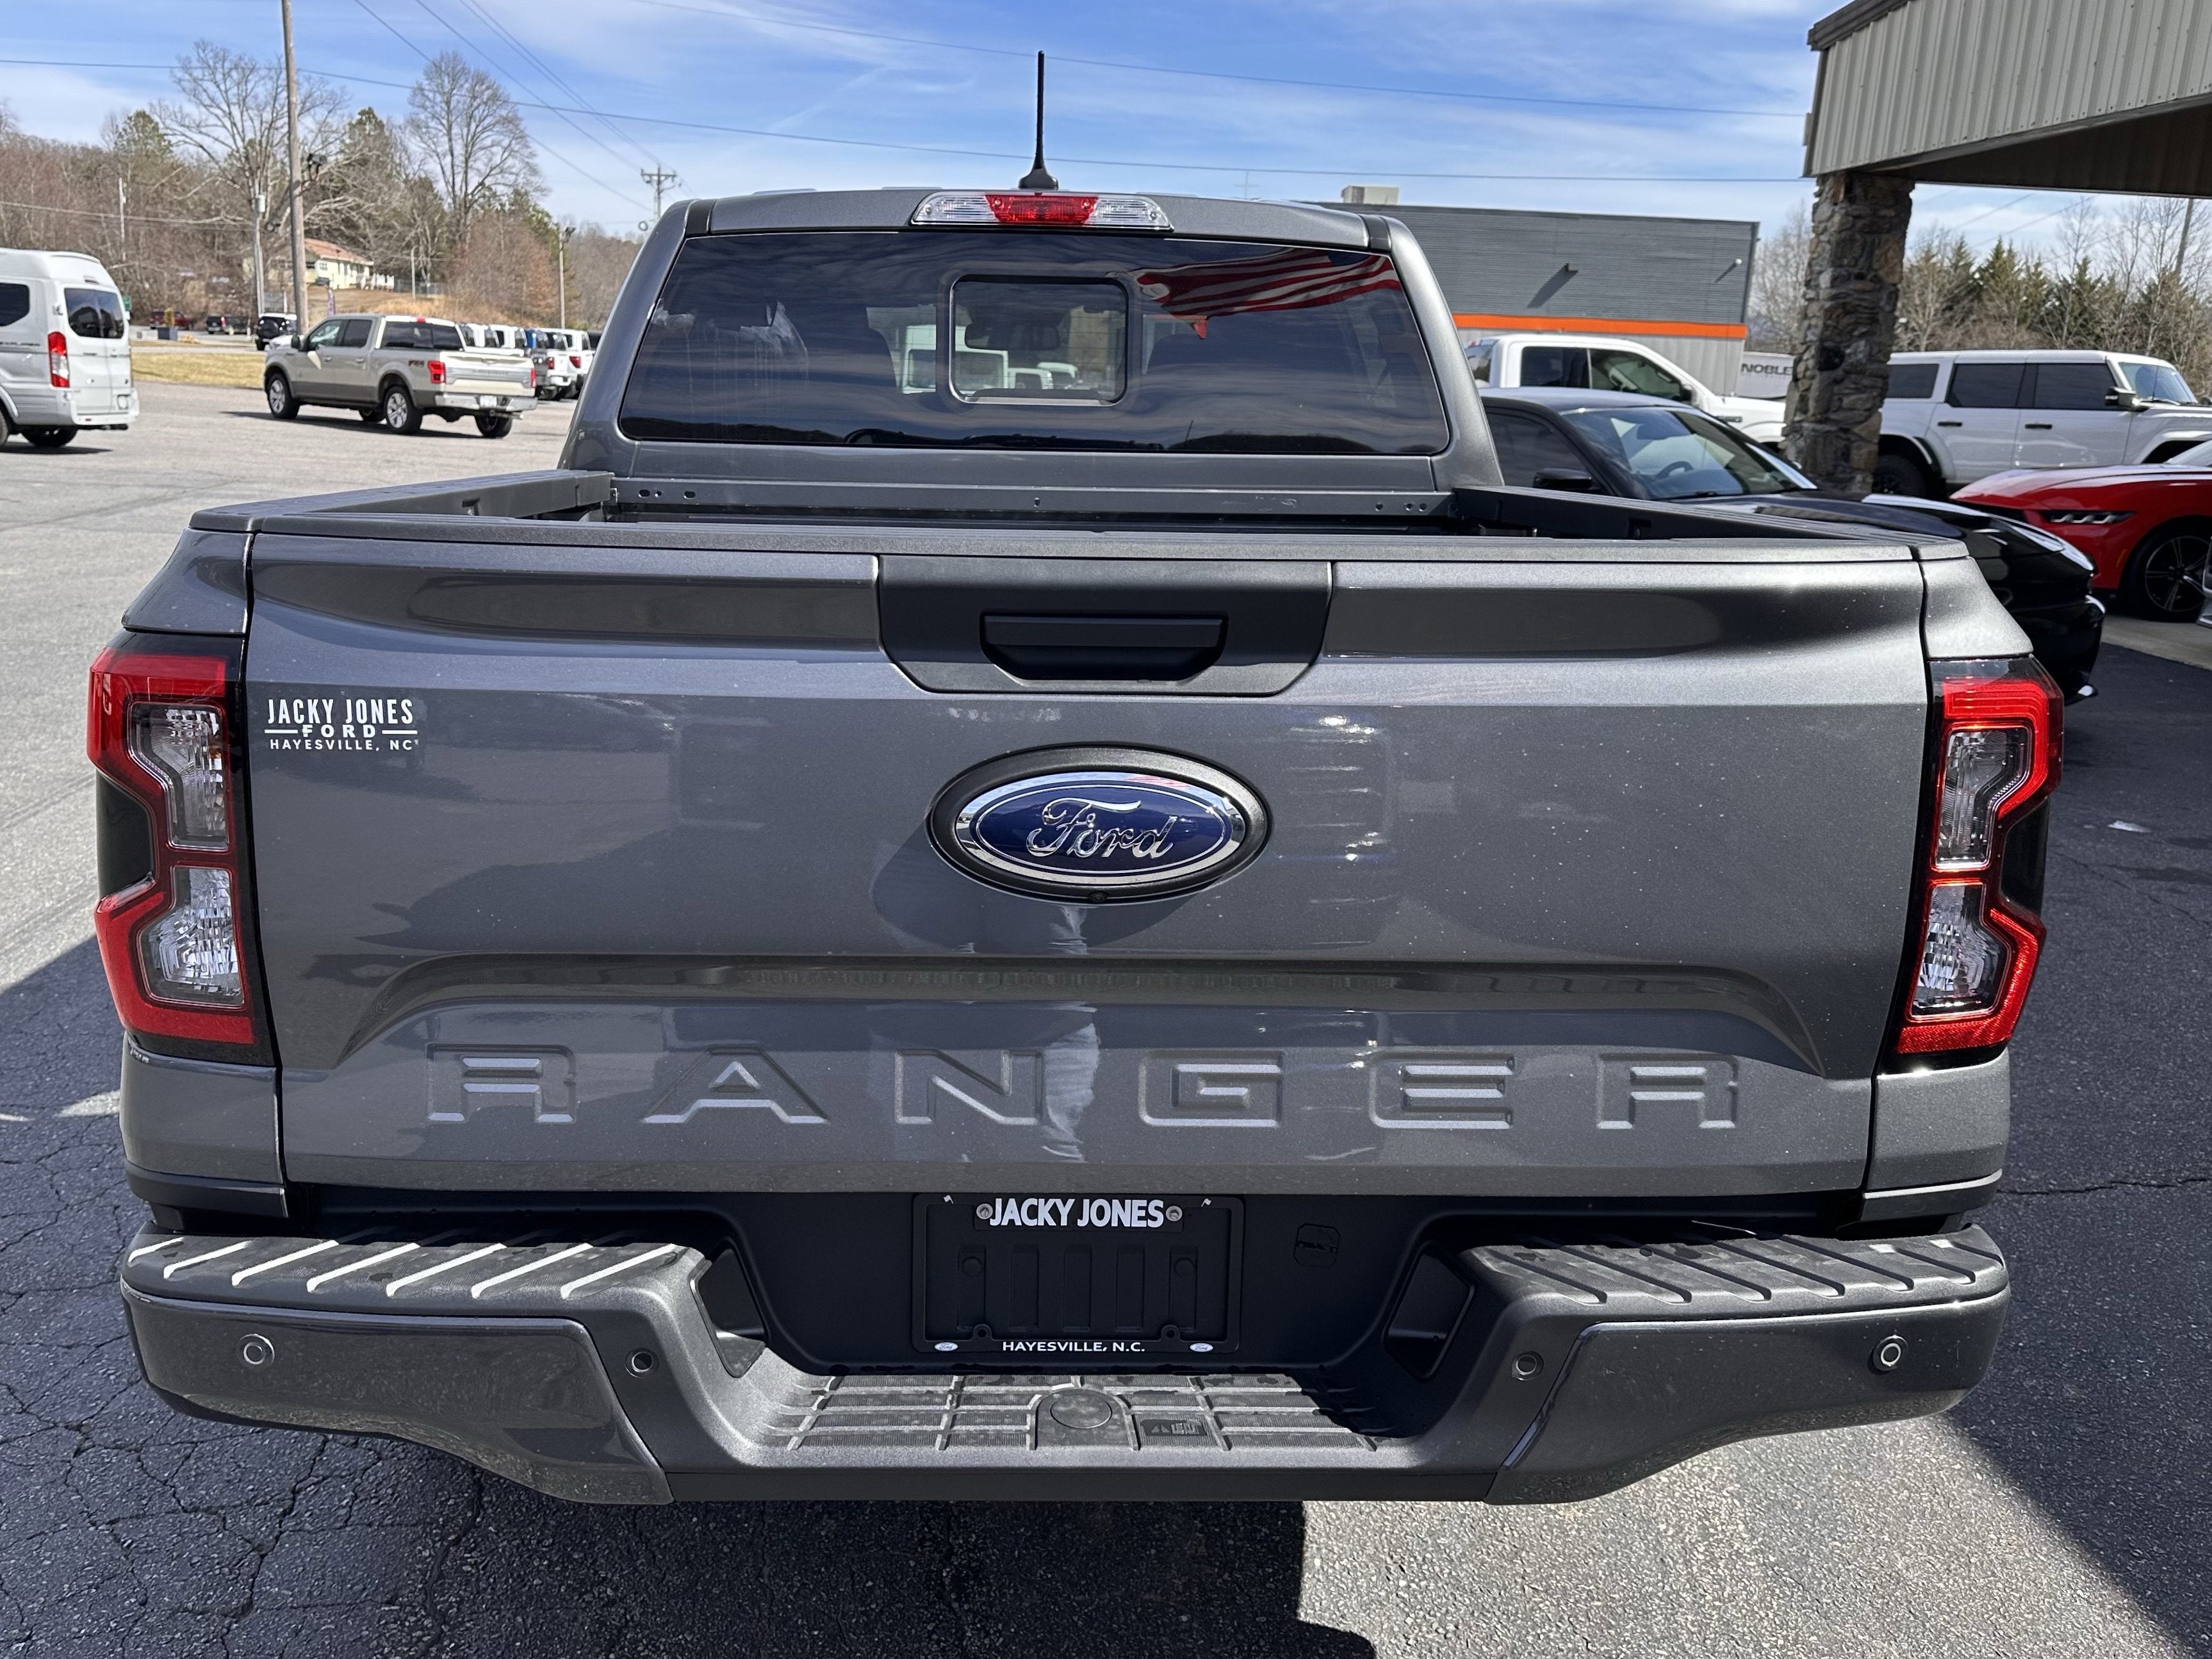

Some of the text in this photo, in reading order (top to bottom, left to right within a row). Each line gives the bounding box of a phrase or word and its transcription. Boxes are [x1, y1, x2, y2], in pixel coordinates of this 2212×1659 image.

[1741, 363, 1794, 375] NOBLE
[268, 698, 414, 725] JACKY JONES
[302, 724, 377, 738] FORD
[269, 739, 381, 752] HAYESVILLE,
[1026, 797, 1179, 859] Ford
[425, 1043, 1741, 1129] RANGER
[989, 1198, 1165, 1228] JACKY JONES
[1002, 1341, 1145, 1352] HAYESVILLE, N.C.
